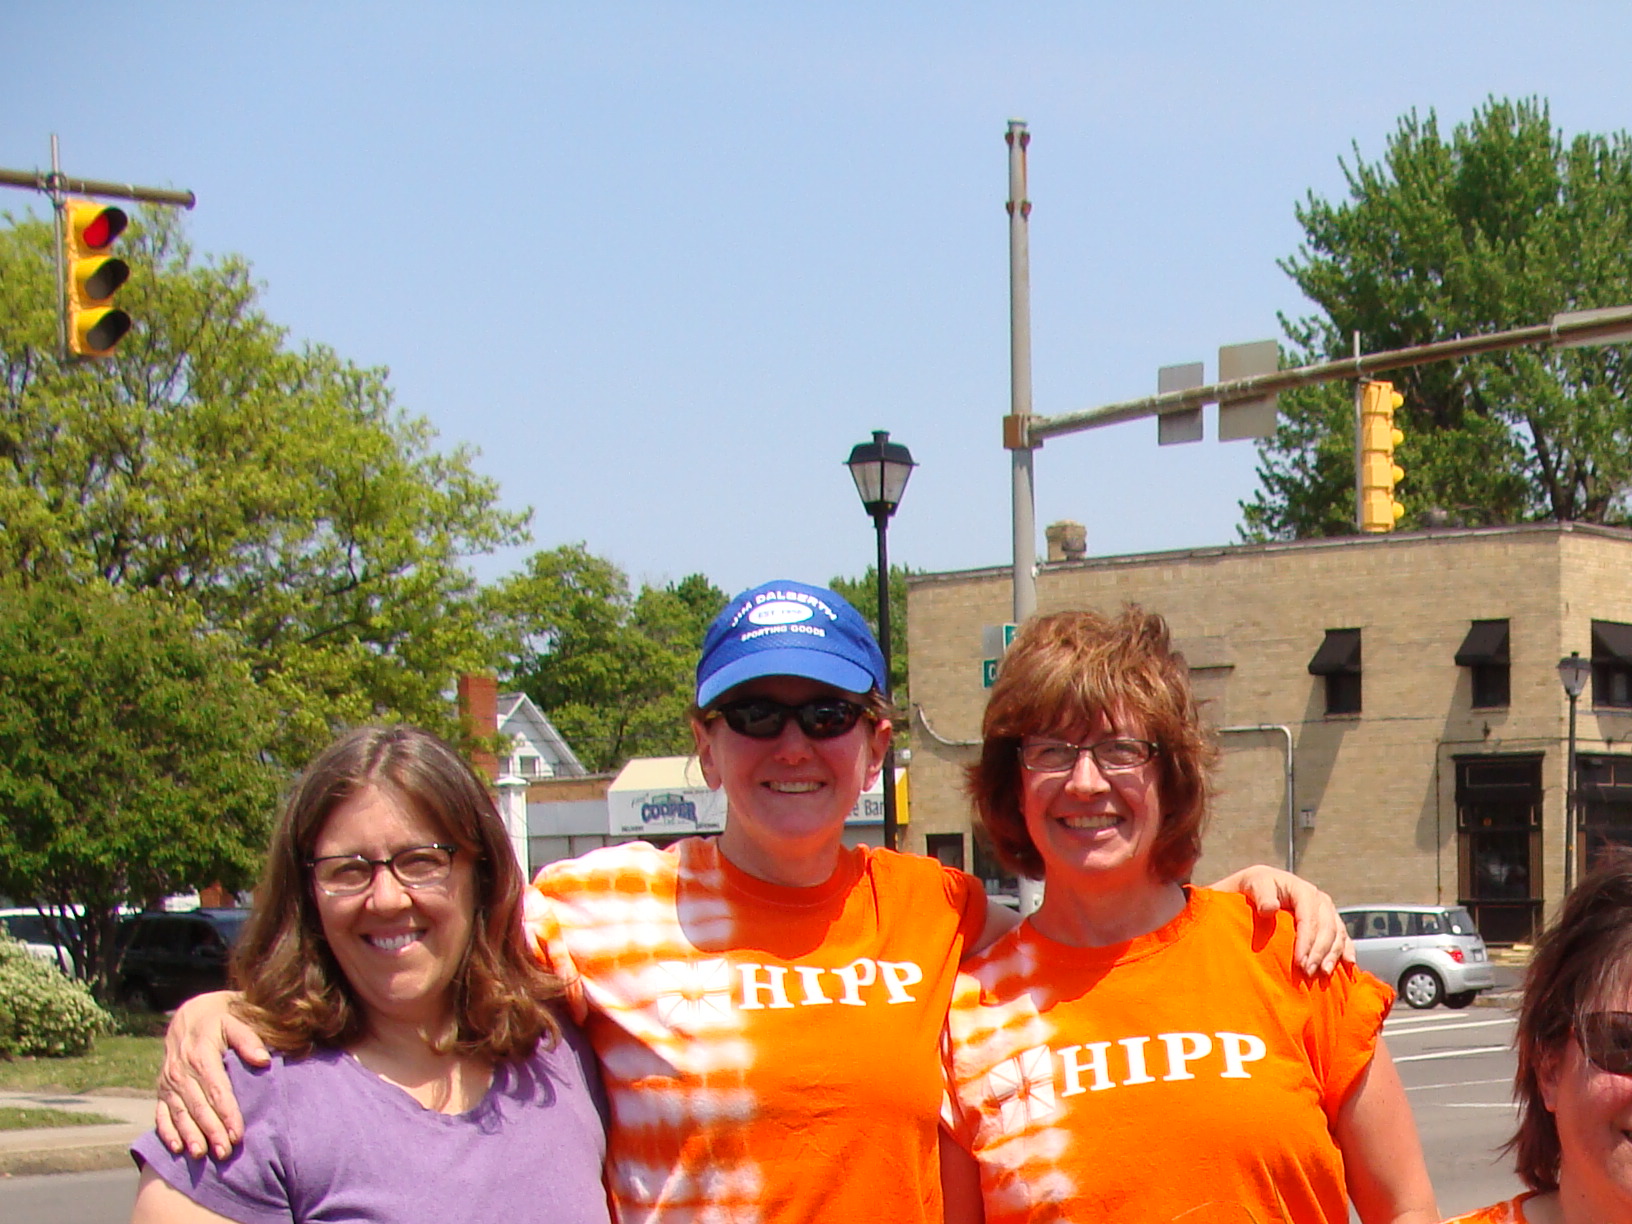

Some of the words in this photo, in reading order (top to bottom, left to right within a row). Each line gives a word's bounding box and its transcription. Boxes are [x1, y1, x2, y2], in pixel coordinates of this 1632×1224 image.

[740, 624, 788, 643] SPORTING
[790, 624, 826, 638] GOODS
[735, 957, 923, 1010] HIPP
[1056, 1031, 1267, 1098] HIPP
